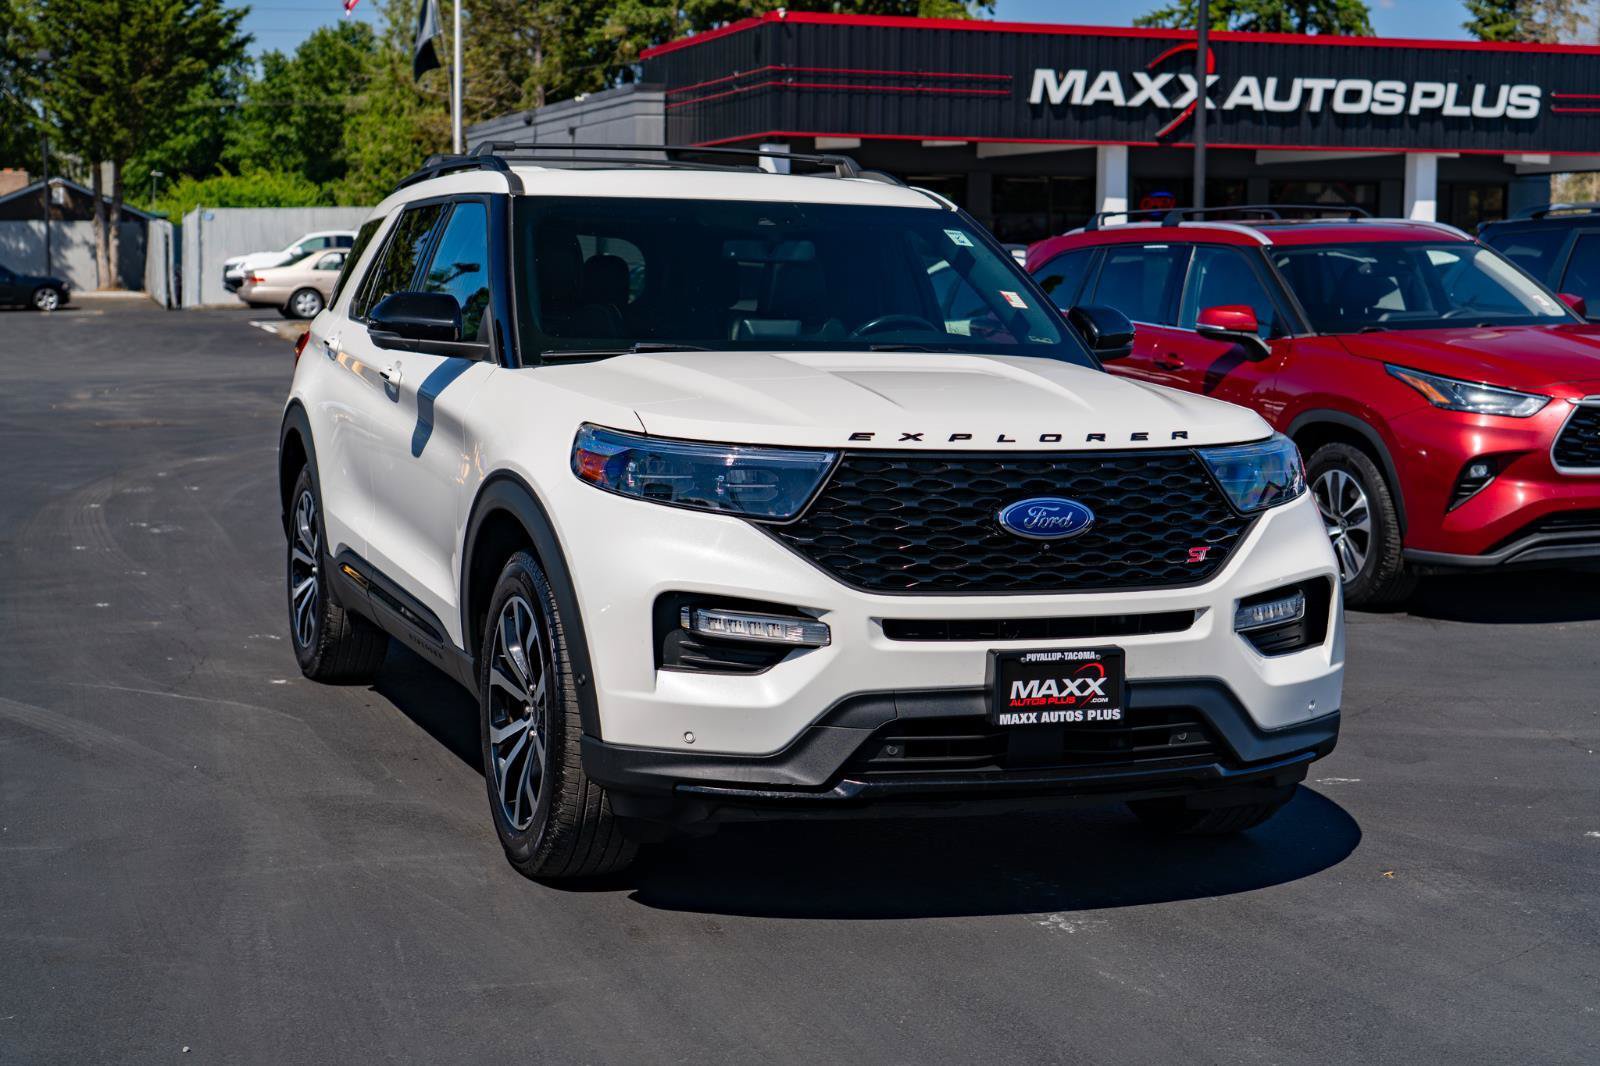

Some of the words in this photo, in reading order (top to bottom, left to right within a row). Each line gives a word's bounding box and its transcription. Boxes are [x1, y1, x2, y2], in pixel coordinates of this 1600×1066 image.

[1029, 68, 1220, 110] MAXX
[1222, 75, 1405, 115] AUTOS
[1409, 80, 1542, 119] PLUS
[848, 430, 1189, 443] EXPLORER
[1024, 506, 1073, 529] Ford
[1187, 546, 1211, 563] ST
[1010, 677, 1108, 699] MAXX
[1009, 697, 1046, 707] AUTOS
[1047, 696, 1076, 705] PLUS
[1000, 712, 1038, 725] MAXX
[1041, 710, 1083, 723] AUTOS
[1087, 708, 1121, 721] PLUS
